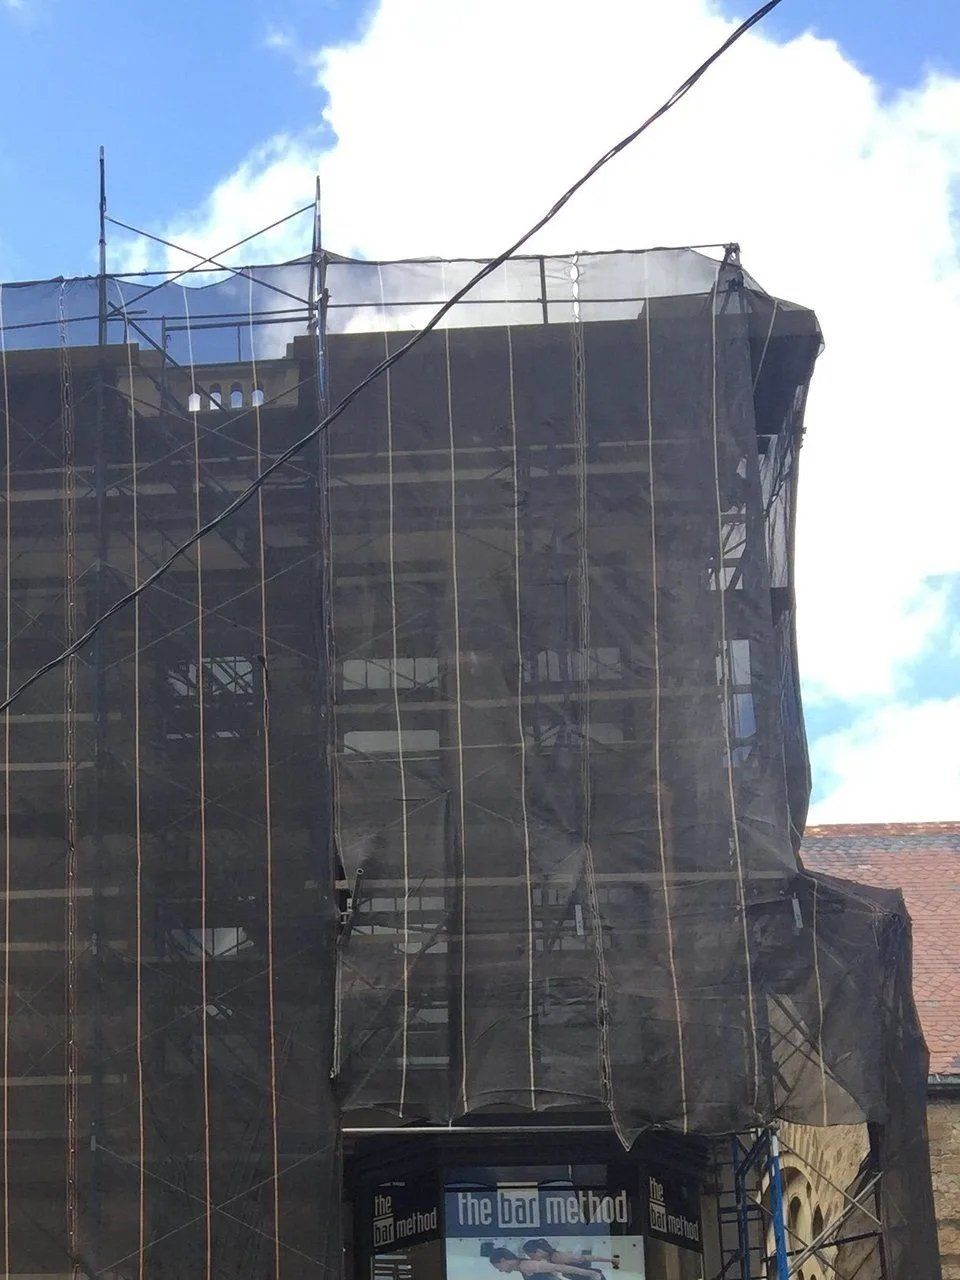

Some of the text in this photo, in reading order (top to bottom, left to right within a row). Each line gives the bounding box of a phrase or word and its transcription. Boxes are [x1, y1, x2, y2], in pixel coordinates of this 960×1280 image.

[375, 1195, 392, 1216] the
[458, 1190, 628, 1227] the bar method
[374, 1207, 437, 1247] bar method
[667, 1215, 699, 1241] method
